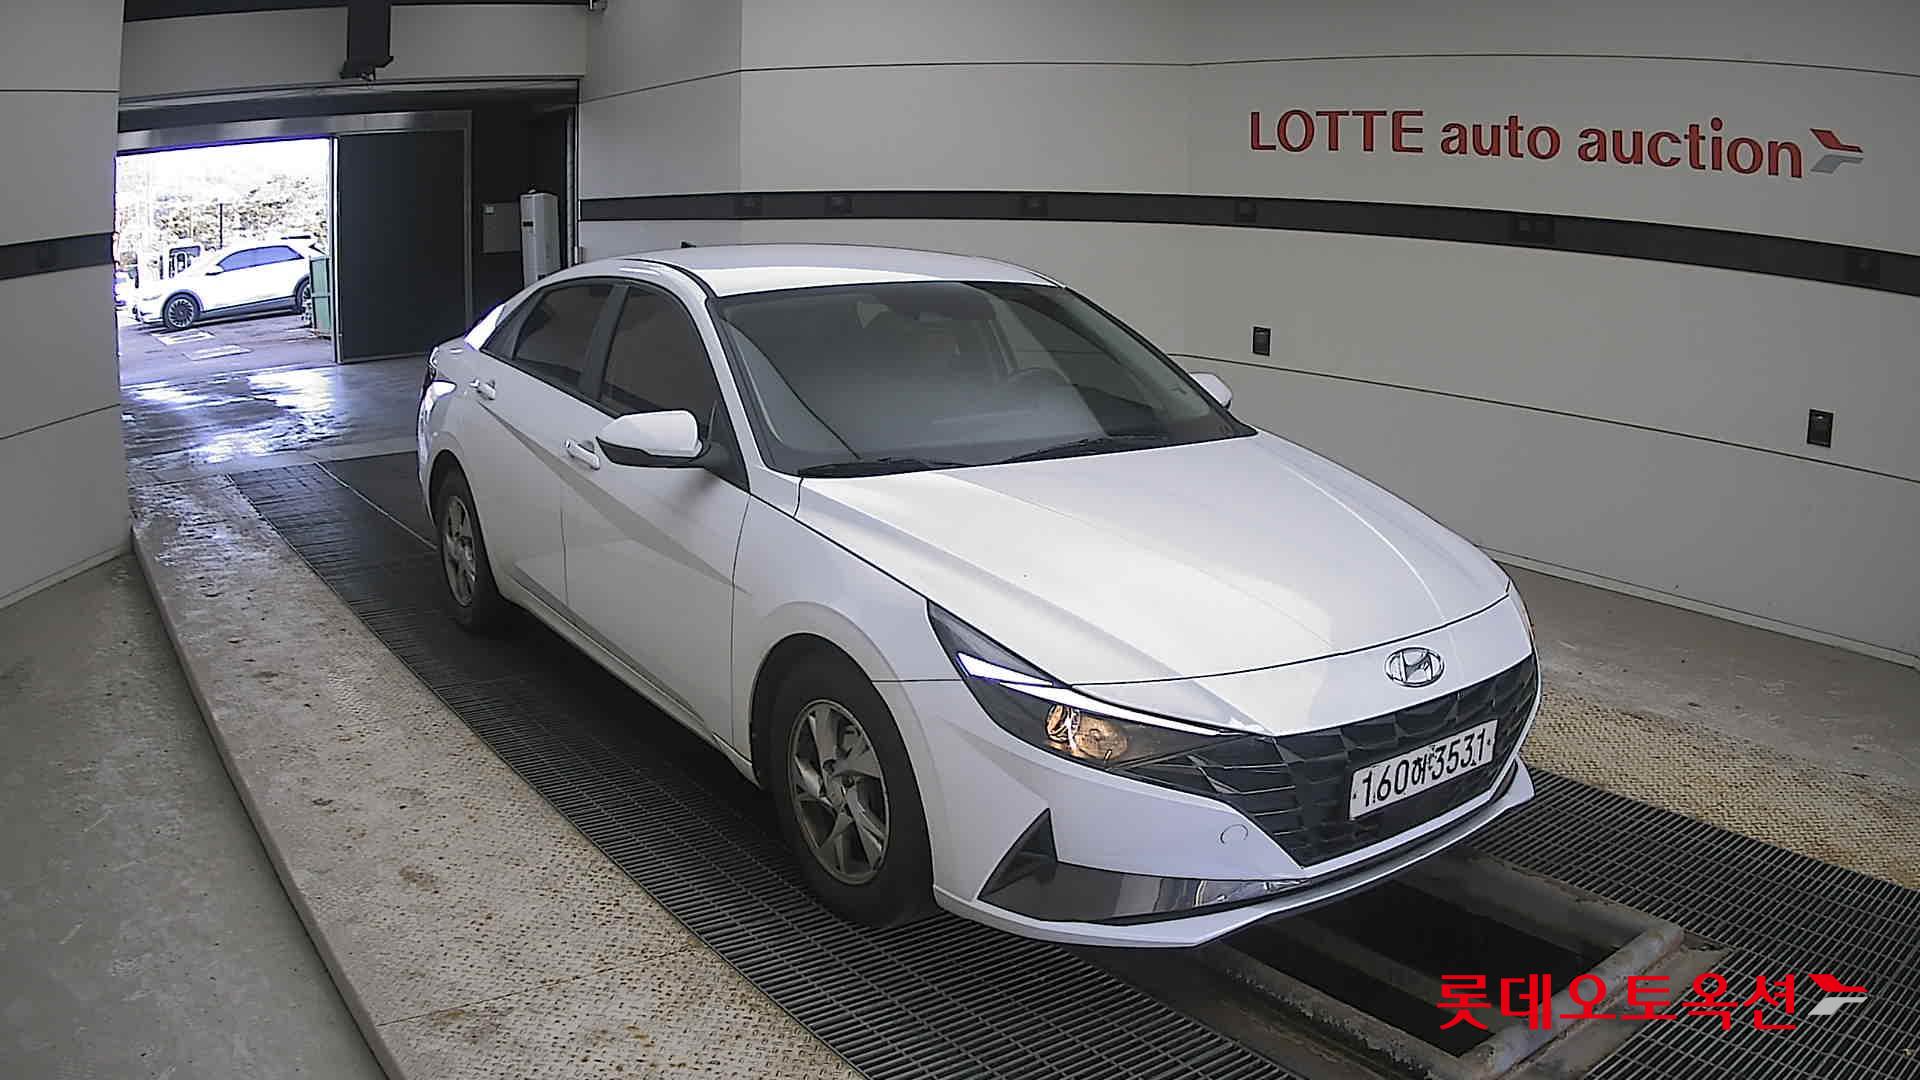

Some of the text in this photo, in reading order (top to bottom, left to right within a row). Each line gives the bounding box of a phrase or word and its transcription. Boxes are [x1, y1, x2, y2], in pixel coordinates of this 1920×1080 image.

[1249, 109, 1803, 178] LOTTE auto auction
